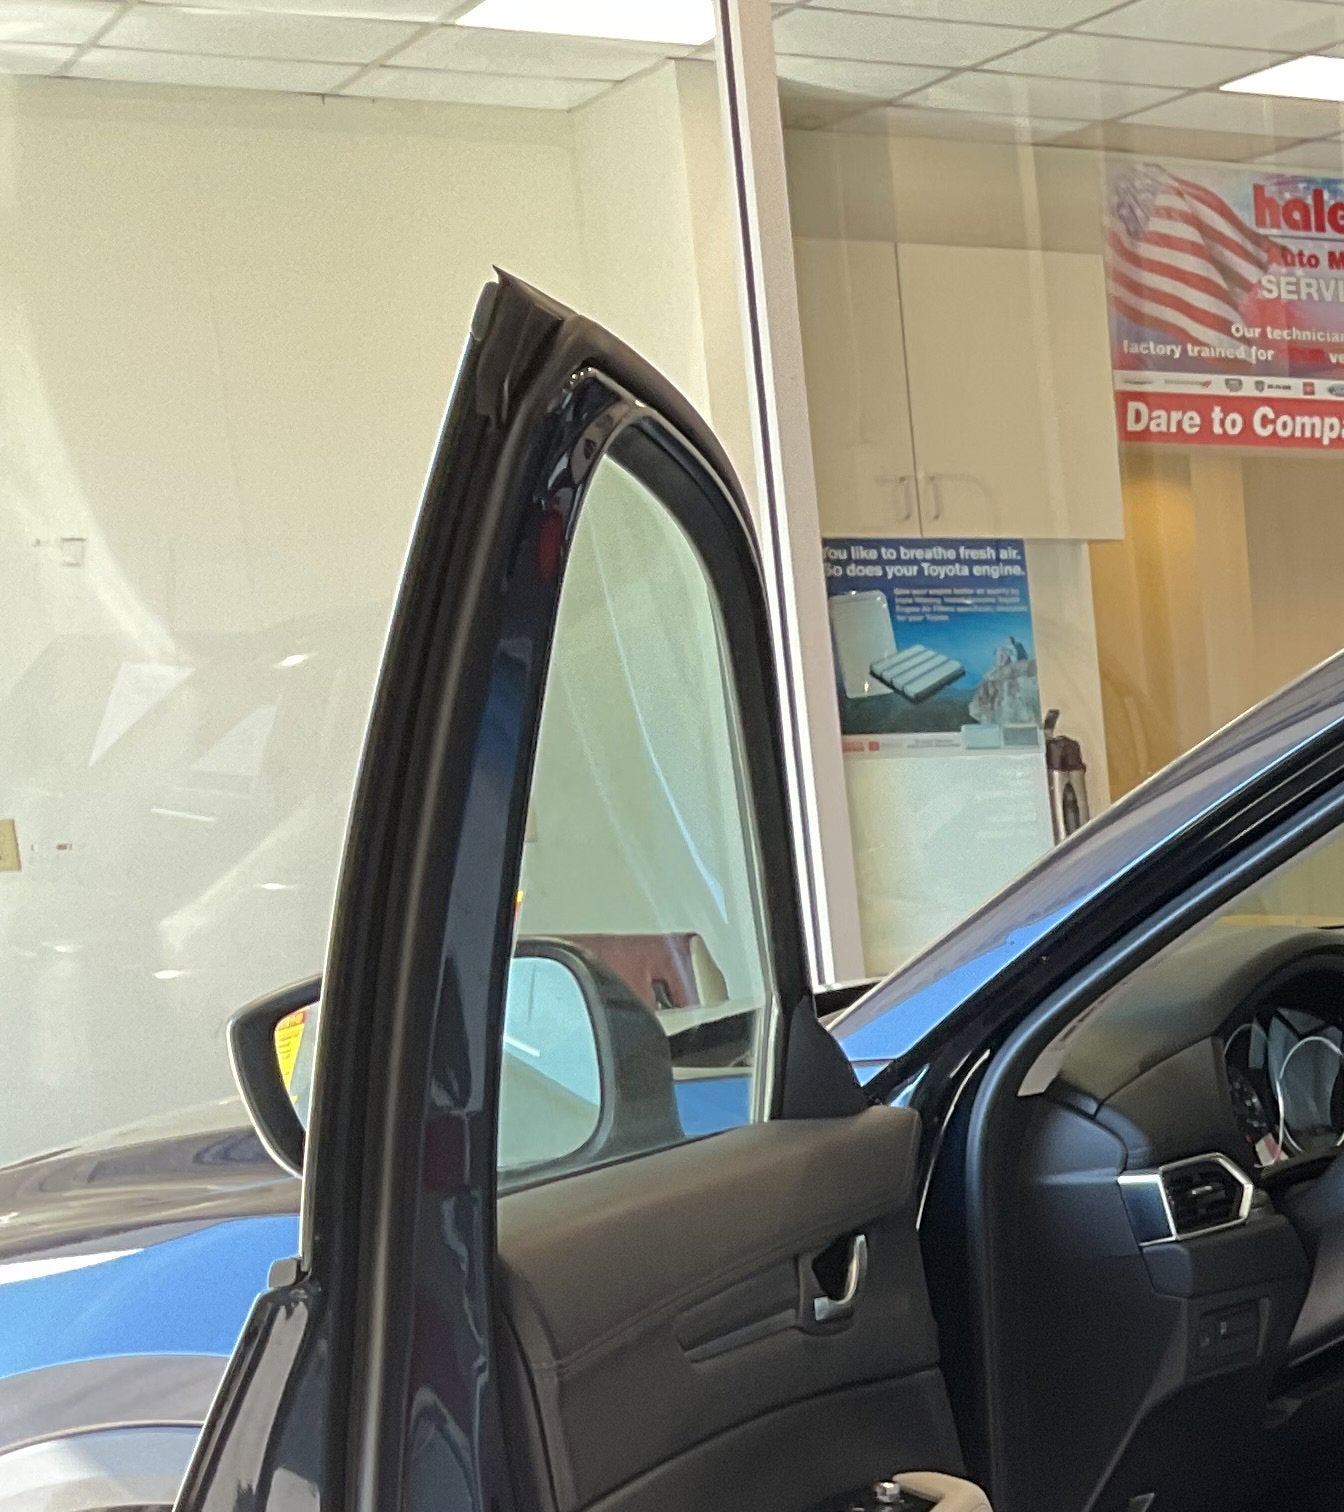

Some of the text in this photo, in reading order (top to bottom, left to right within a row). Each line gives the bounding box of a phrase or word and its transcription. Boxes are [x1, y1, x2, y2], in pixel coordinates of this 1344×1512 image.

[1267, 246, 1320, 269] Auto
[1230, 322, 1261, 339] Our
[1123, 340, 1182, 359] factory
[1186, 343, 1245, 359] trained
[1250, 345, 1275, 364] for
[1126, 400, 1201, 434] Dare
[1211, 405, 1243, 435] to
[850, 545, 879, 560] like
[881, 546, 897, 560] to
[900, 545, 957, 560] breathe
[959, 545, 996, 560] fresh
[999, 546, 1022, 560] air.
[846, 562, 884, 577] does
[885, 564, 918, 580] your
[920, 561, 970, 580] Toyota
[972, 563, 1026, 580] engine.
